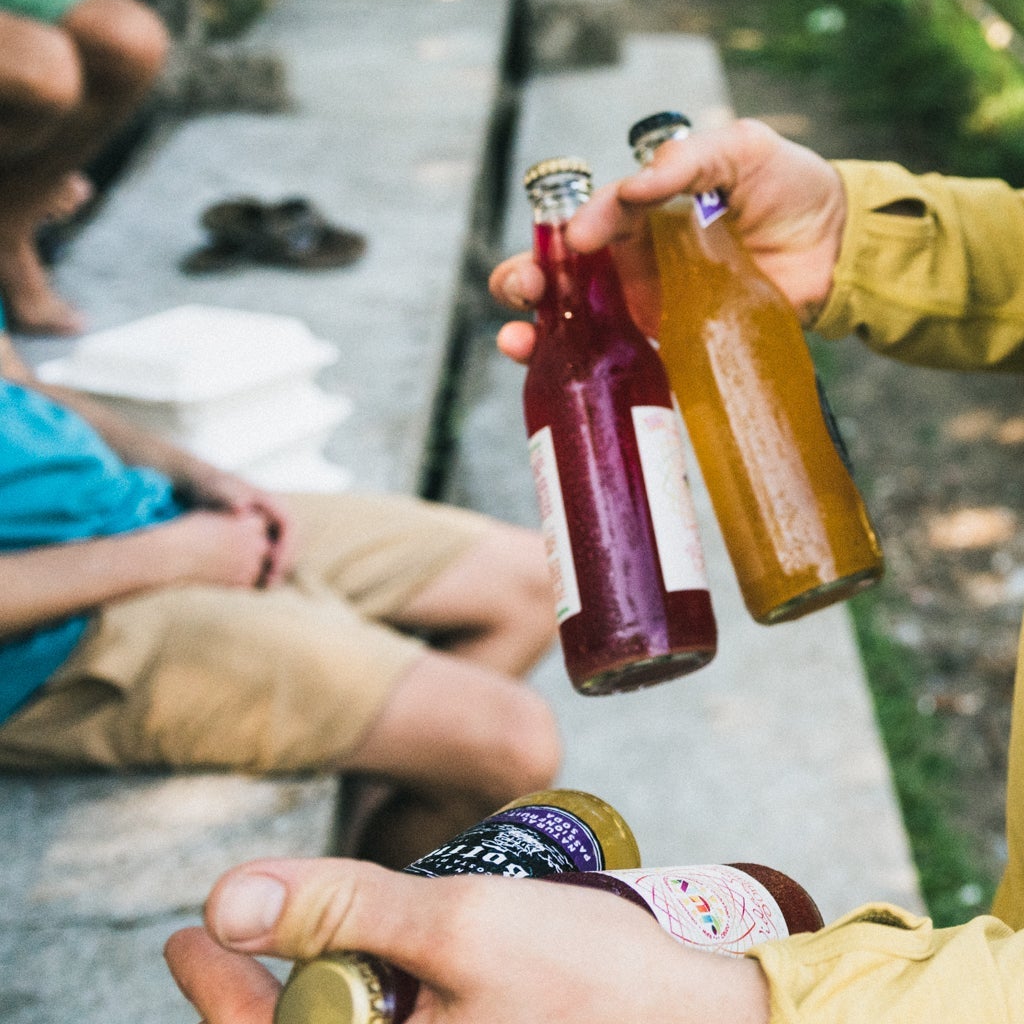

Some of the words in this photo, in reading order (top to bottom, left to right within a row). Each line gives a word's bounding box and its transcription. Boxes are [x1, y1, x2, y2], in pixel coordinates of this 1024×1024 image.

[506, 810, 591, 862] PASSIONFRUIT
[522, 816, 575, 852] NATURAL
[546, 813, 579, 834] SODA
